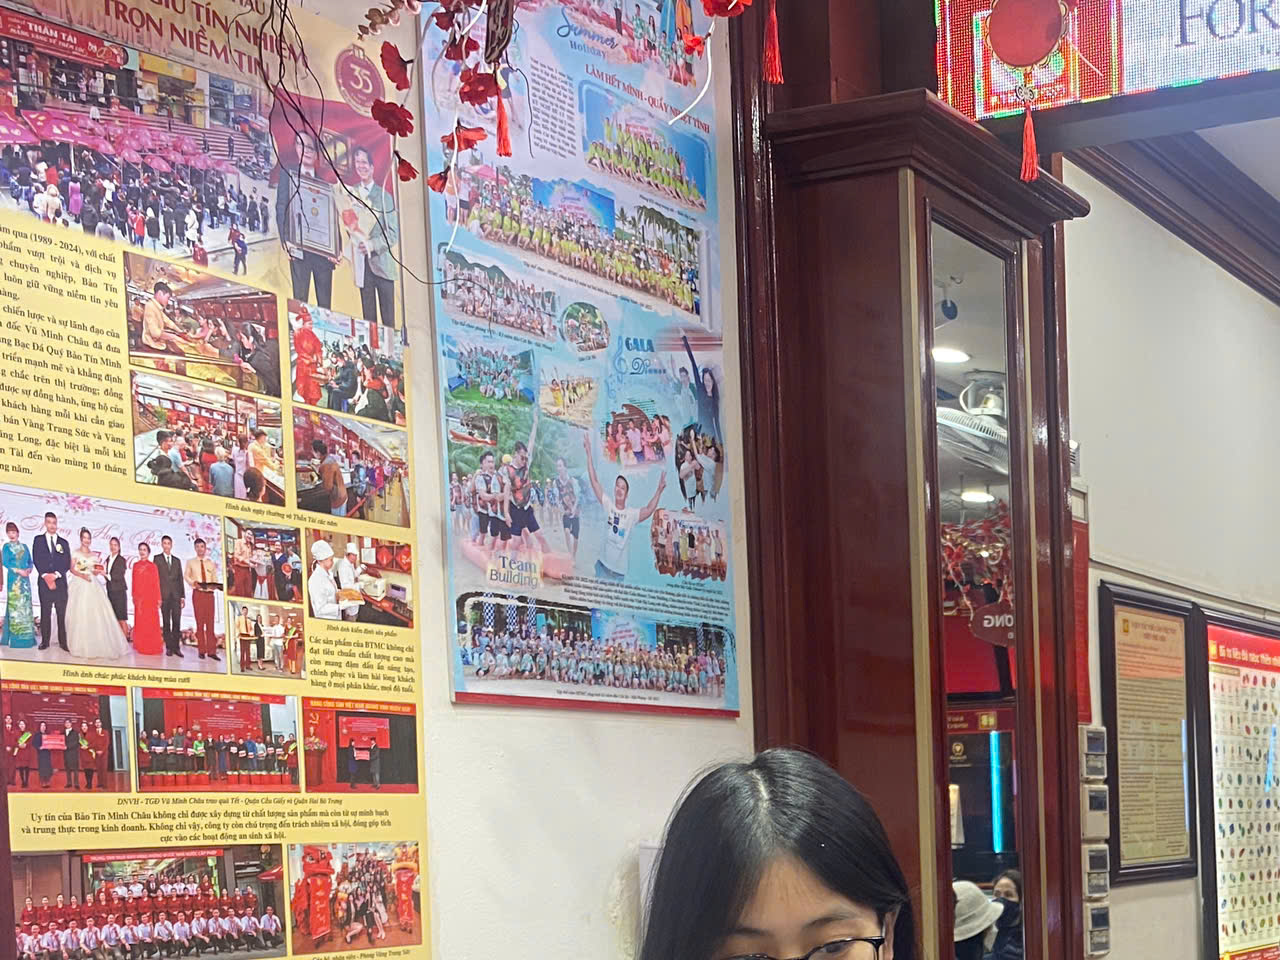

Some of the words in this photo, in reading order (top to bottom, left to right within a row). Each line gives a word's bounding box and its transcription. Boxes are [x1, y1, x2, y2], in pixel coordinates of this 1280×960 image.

[557, 7, 619, 49] Summer
[102, 0, 163, 36] TRỌN
[170, 25, 229, 64] NIỀM
[235, 51, 271, 81] TIN
[570, 40, 607, 59] Holiday
[350, 64, 373, 93] 35
[499, 556, 536, 573] Team
[490, 569, 538, 589] Building
[365, 641, 385, 649] BTMC
